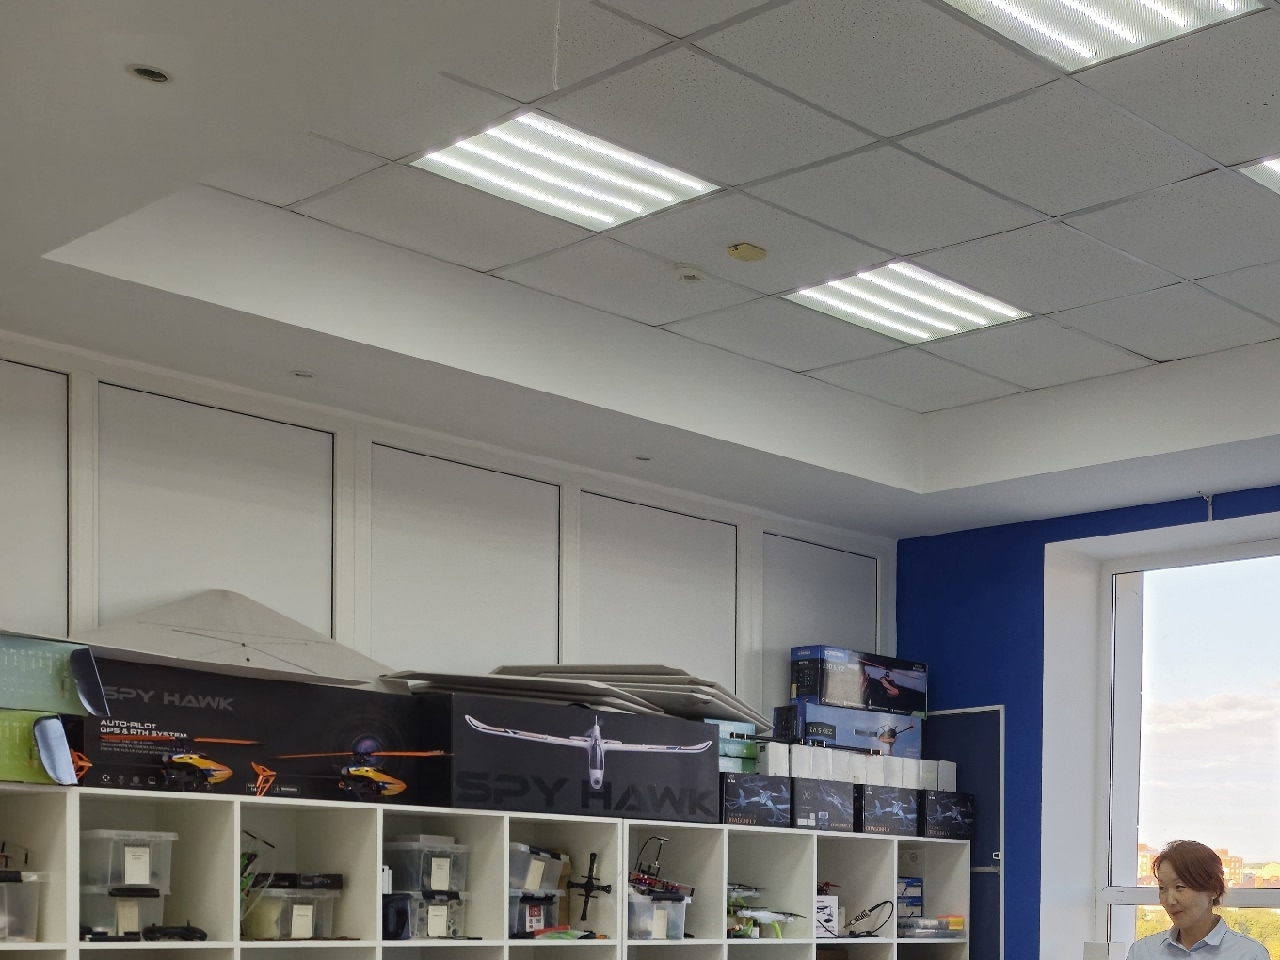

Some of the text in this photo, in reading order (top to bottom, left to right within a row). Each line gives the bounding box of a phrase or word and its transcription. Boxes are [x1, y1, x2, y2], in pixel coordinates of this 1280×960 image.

[104, 686, 234, 712] SPY HAWK
[100, 727, 121, 735] GPS
[130, 729, 149, 737] RTH
[455, 771, 718, 818] SPY HAWK
